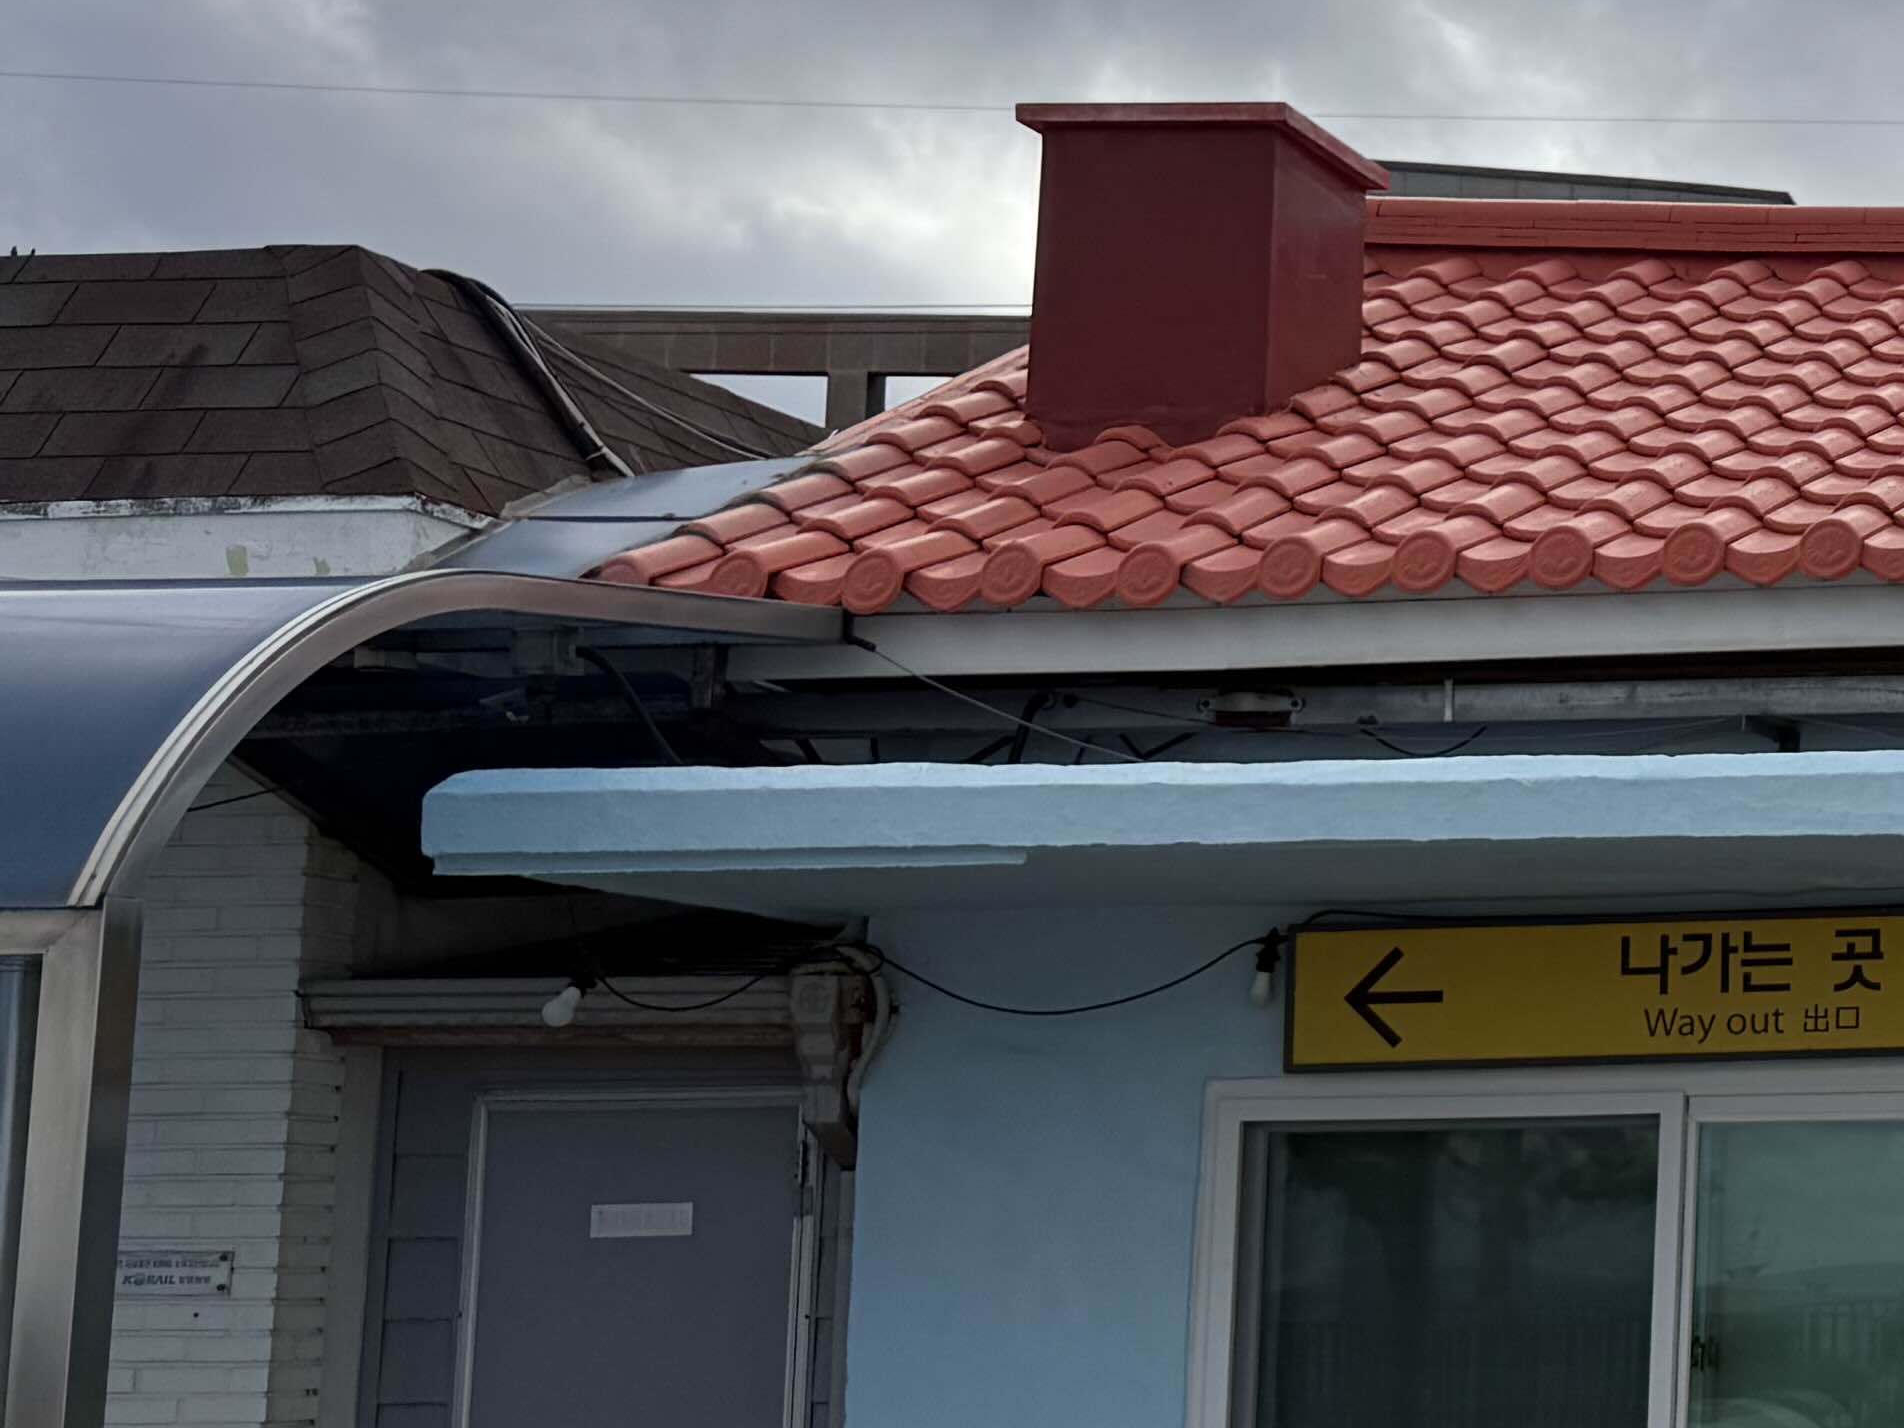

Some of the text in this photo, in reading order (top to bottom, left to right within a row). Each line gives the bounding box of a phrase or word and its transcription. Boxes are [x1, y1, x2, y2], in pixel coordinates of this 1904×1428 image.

[1620, 927, 1885, 996] 나가는 곳
[1643, 1003, 1861, 1045] Way out 出口
